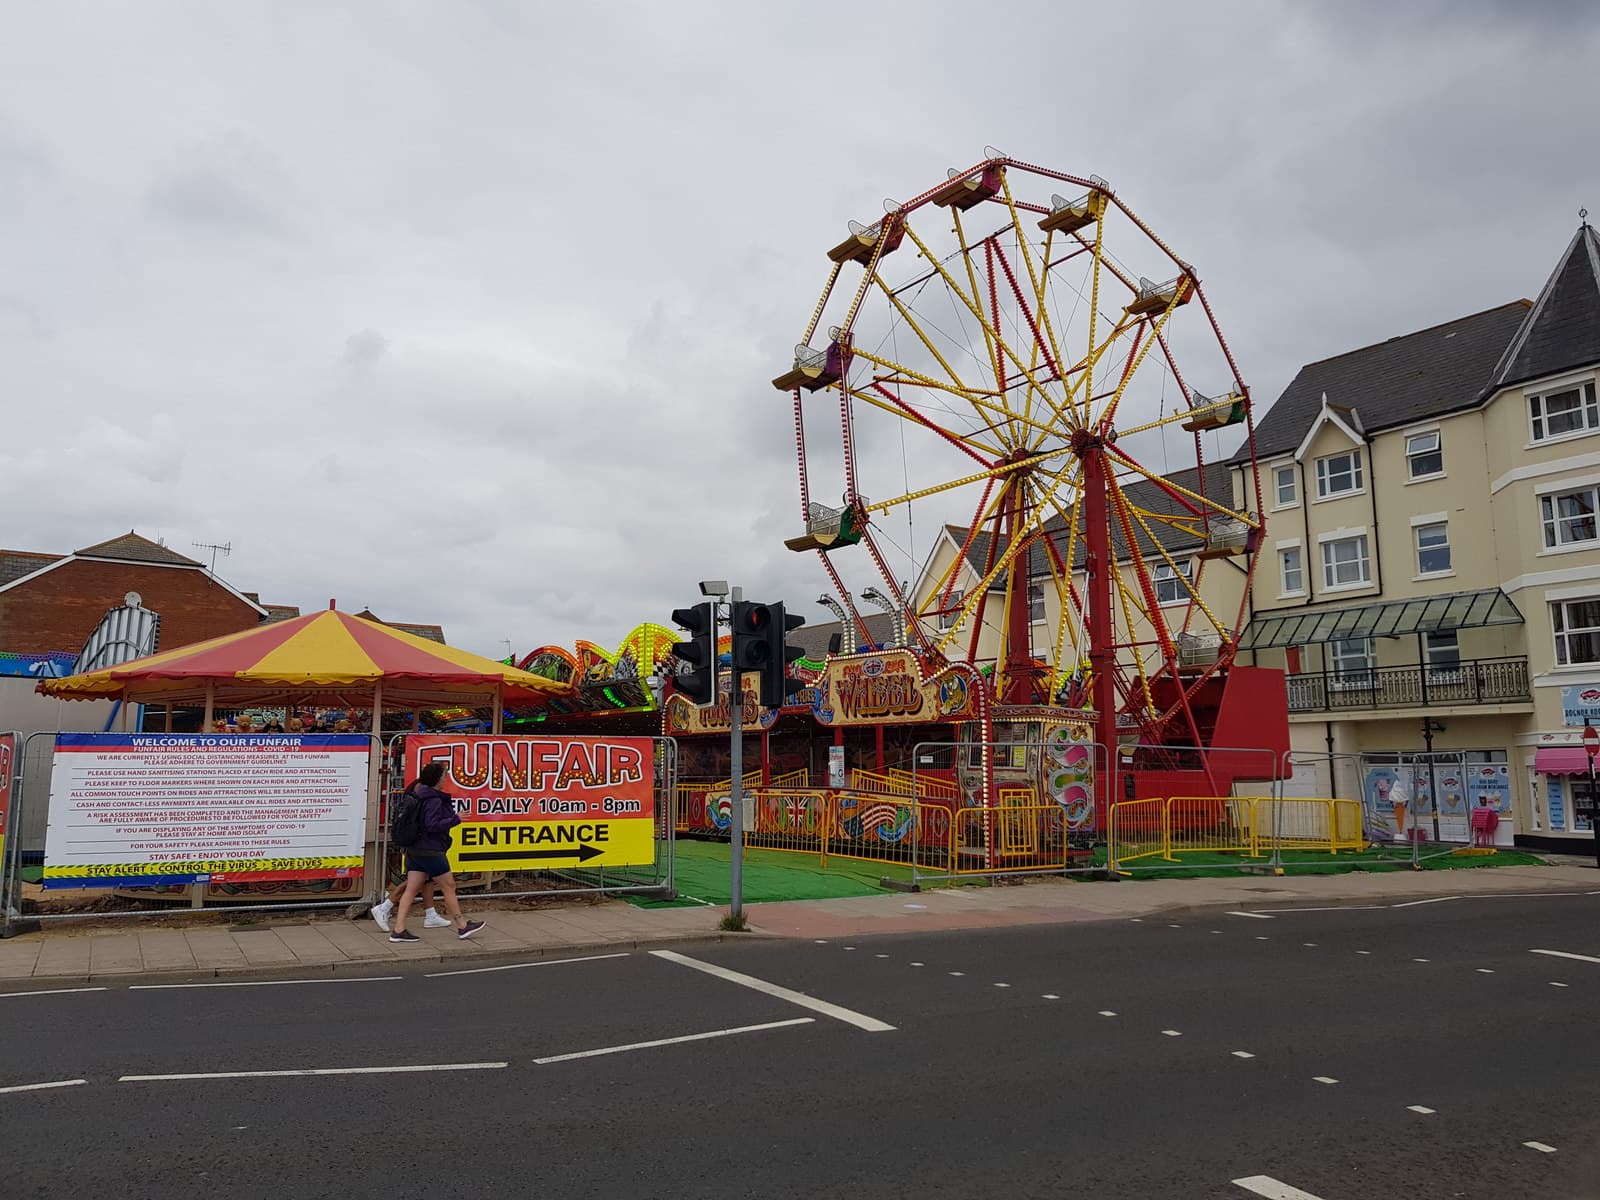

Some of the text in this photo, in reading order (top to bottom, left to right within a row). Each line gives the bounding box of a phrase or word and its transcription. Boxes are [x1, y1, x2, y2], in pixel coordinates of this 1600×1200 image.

[418, 740, 642, 791] FUNFAIR
[452, 799, 471, 813] EN
[477, 798, 533, 814] DAILY
[539, 799, 586, 814] 10am
[604, 798, 640, 814] 8pm
[462, 824, 609, 846] ENTRANCE
